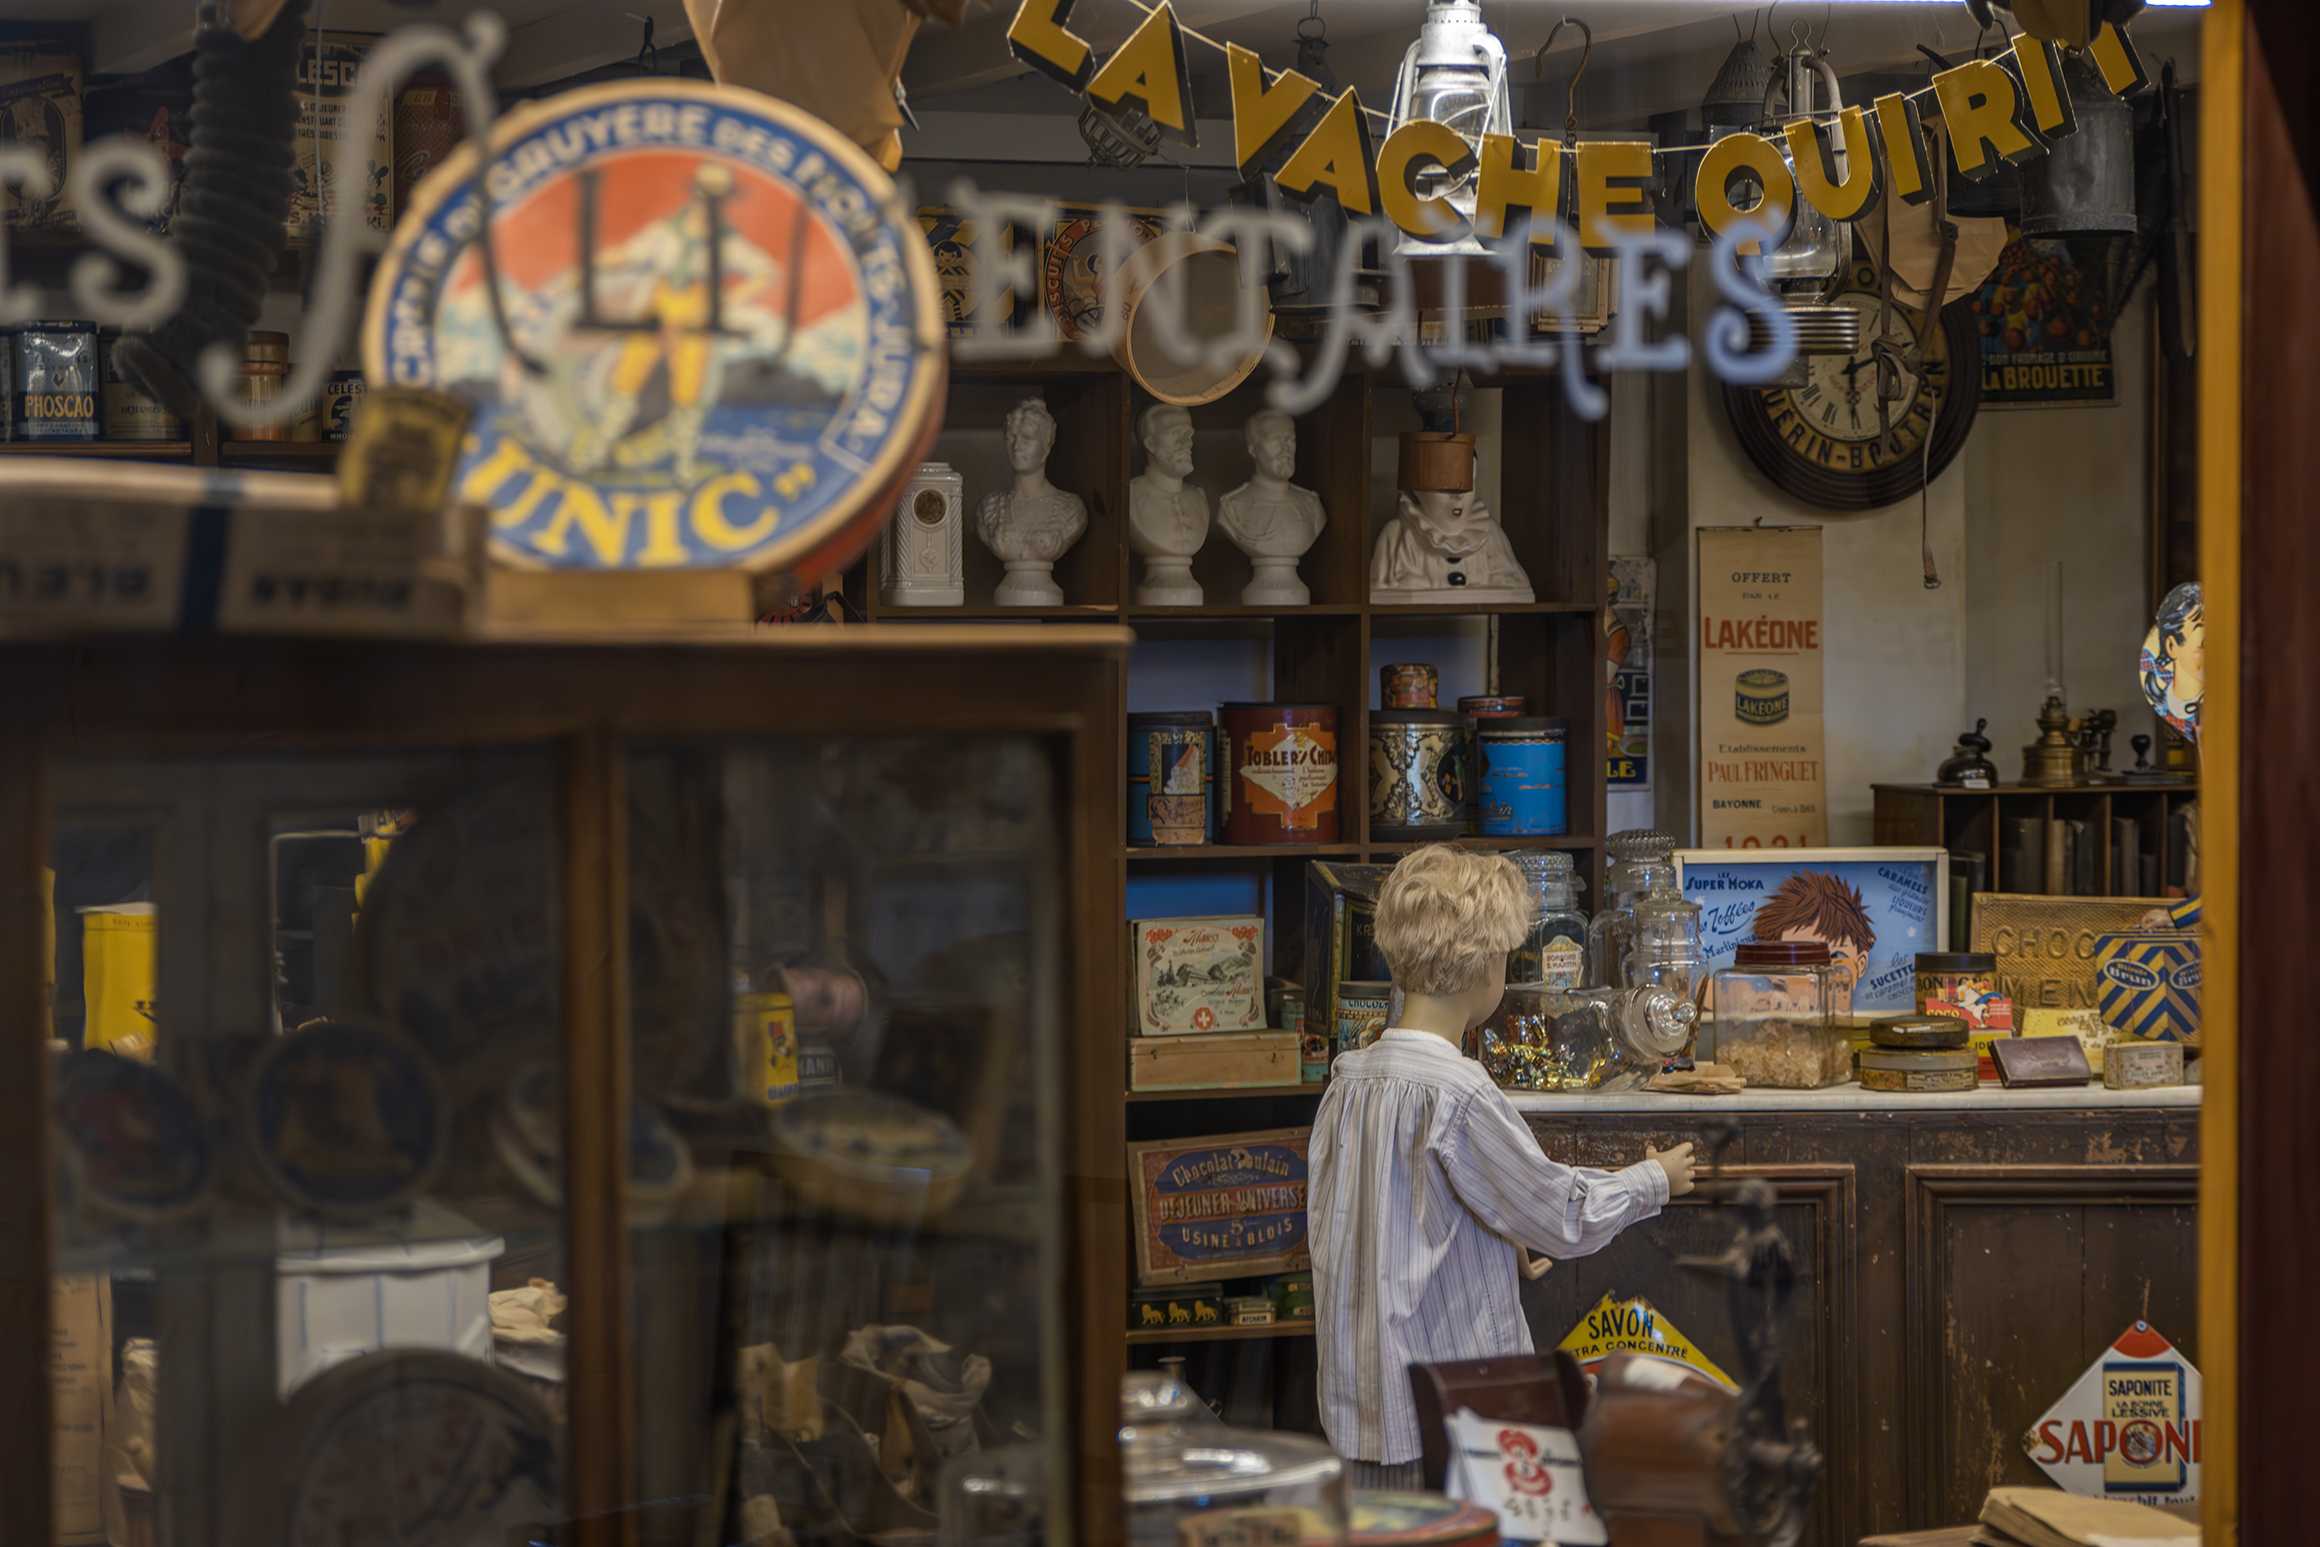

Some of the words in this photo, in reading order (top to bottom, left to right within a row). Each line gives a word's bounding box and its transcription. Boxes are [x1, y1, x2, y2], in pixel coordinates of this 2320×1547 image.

[1008, 0, 1198, 148] LA
[1220, 40, 1656, 258] VACHE
[1694, 92, 1938, 258] QUI
[2002, 365, 2105, 391] BROUETTE
[23, 394, 95, 419] PHOSCAO
[1730, 571, 1792, 584] OFFERT
[1704, 614, 1819, 650] LAKÉONE
[1707, 760, 1742, 783] PAUL
[1712, 799, 1763, 810] BAYONNE
[1685, 876, 1726, 891] SUPER
[1727, 876, 1765, 891] MOKA
[2109, 964, 2152, 987] Brun
[1171, 1152, 1233, 1187] Chocolat
[1181, 1226, 1230, 1249] USINE
[1247, 1216, 1294, 1248] BLOIS
[1587, 1307, 1654, 1340] SAVON
[2108, 1379, 2172, 1397] SAPONITE
[2111, 1407, 2170, 1418] LESSIVE
[2115, 1400, 2129, 1409] LA
